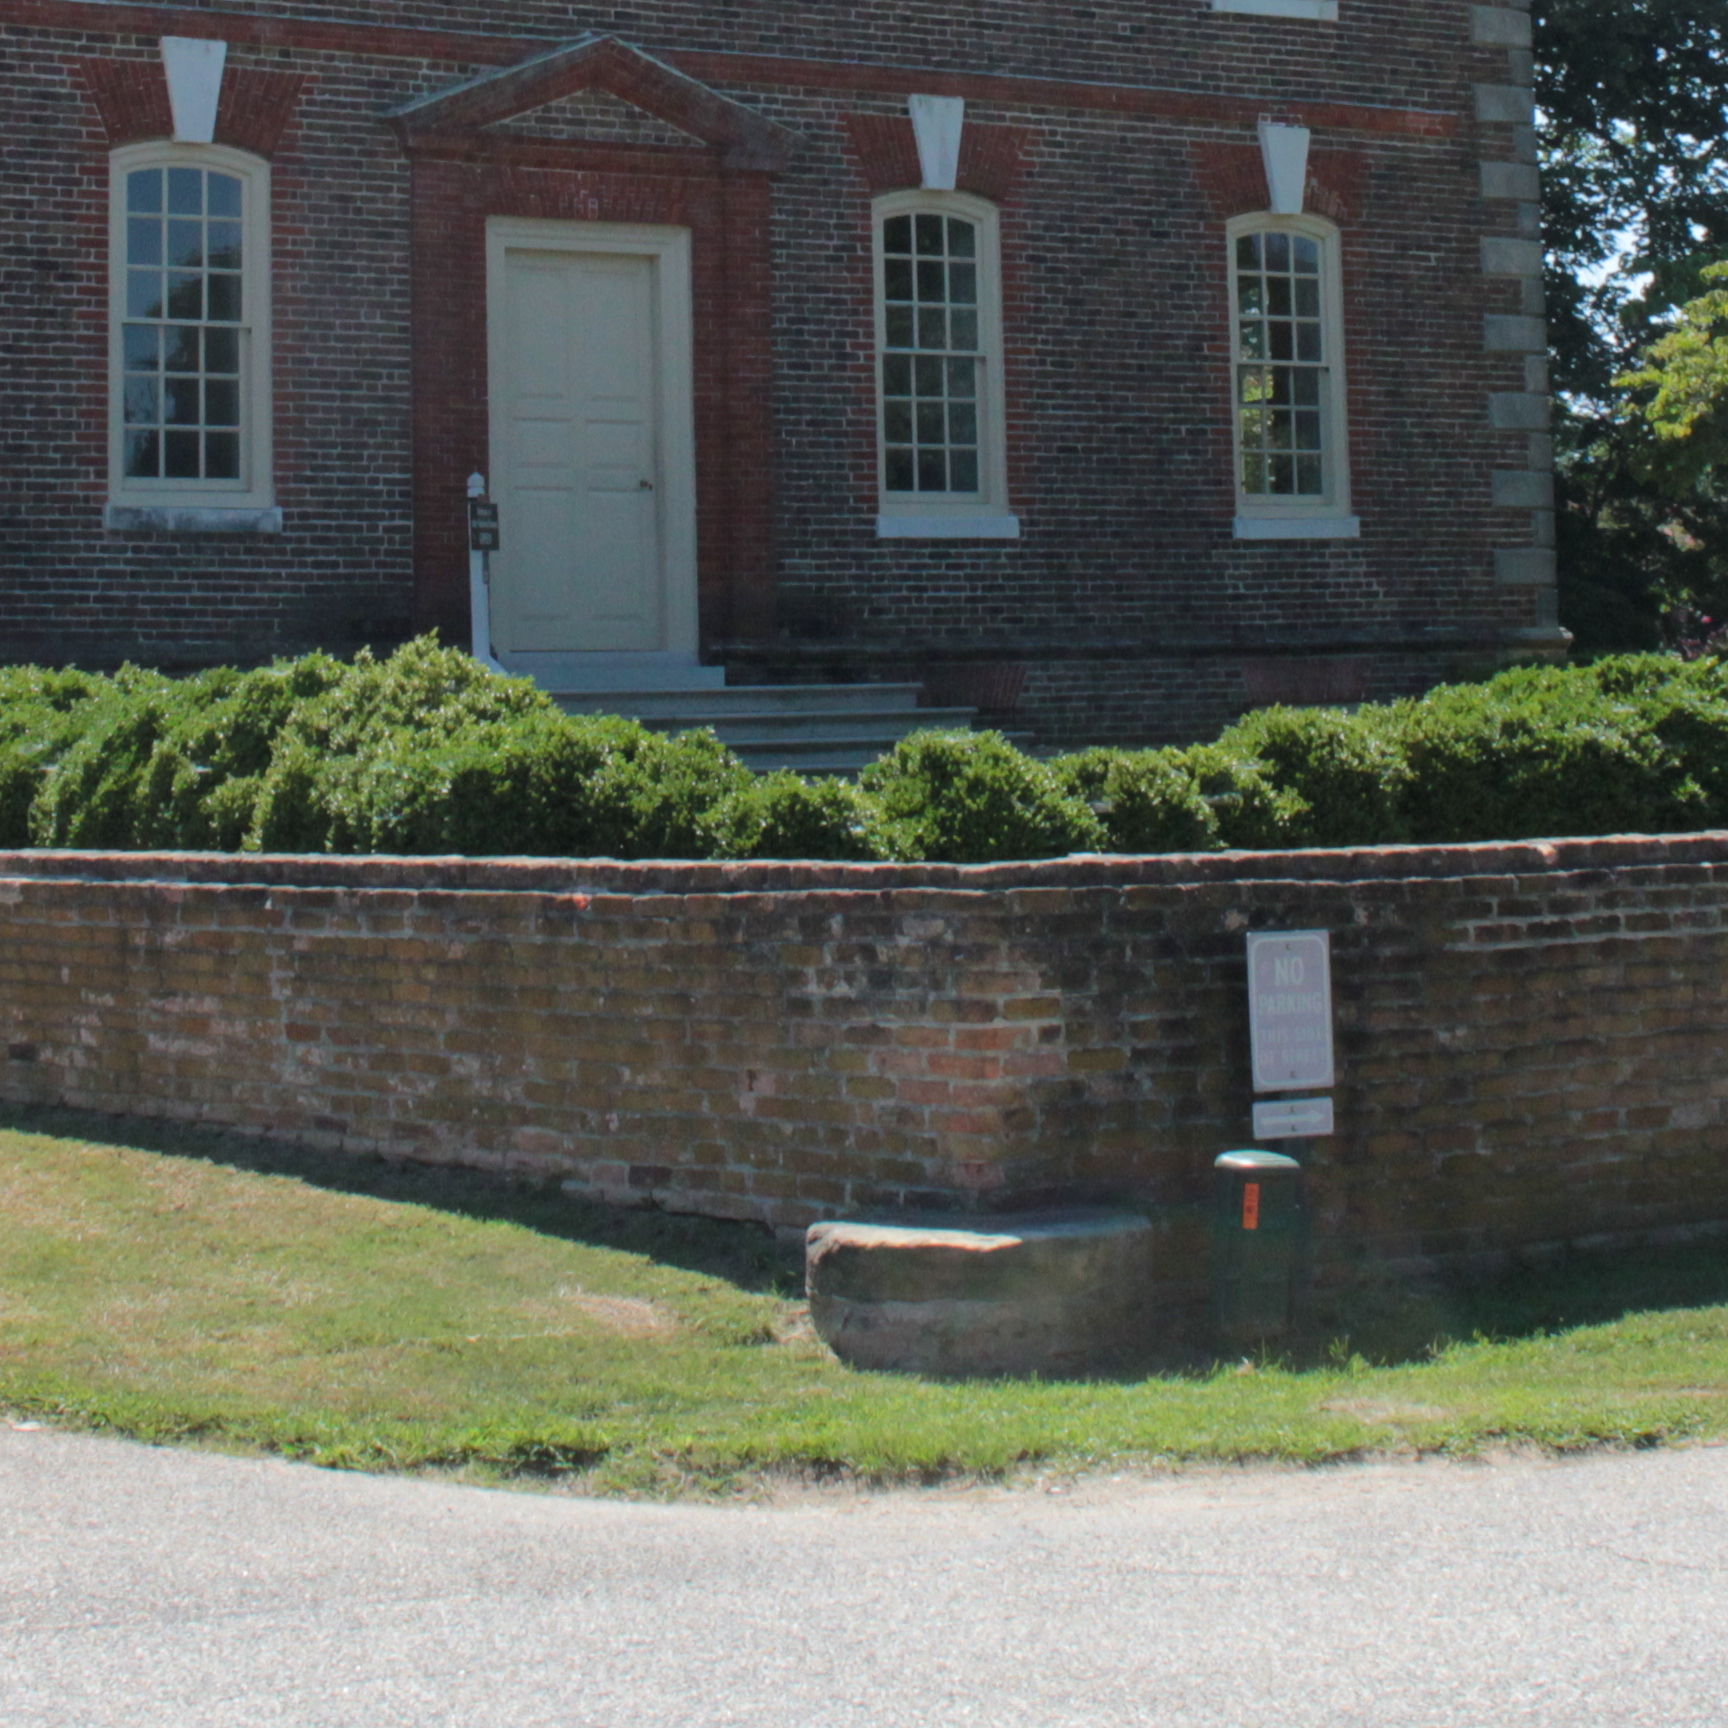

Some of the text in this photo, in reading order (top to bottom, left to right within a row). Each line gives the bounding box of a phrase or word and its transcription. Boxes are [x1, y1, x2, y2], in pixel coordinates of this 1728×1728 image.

[1274, 956, 1305, 986] NO
[1257, 992, 1323, 1018] PARKING
[1258, 1029, 1290, 1043] THIS
